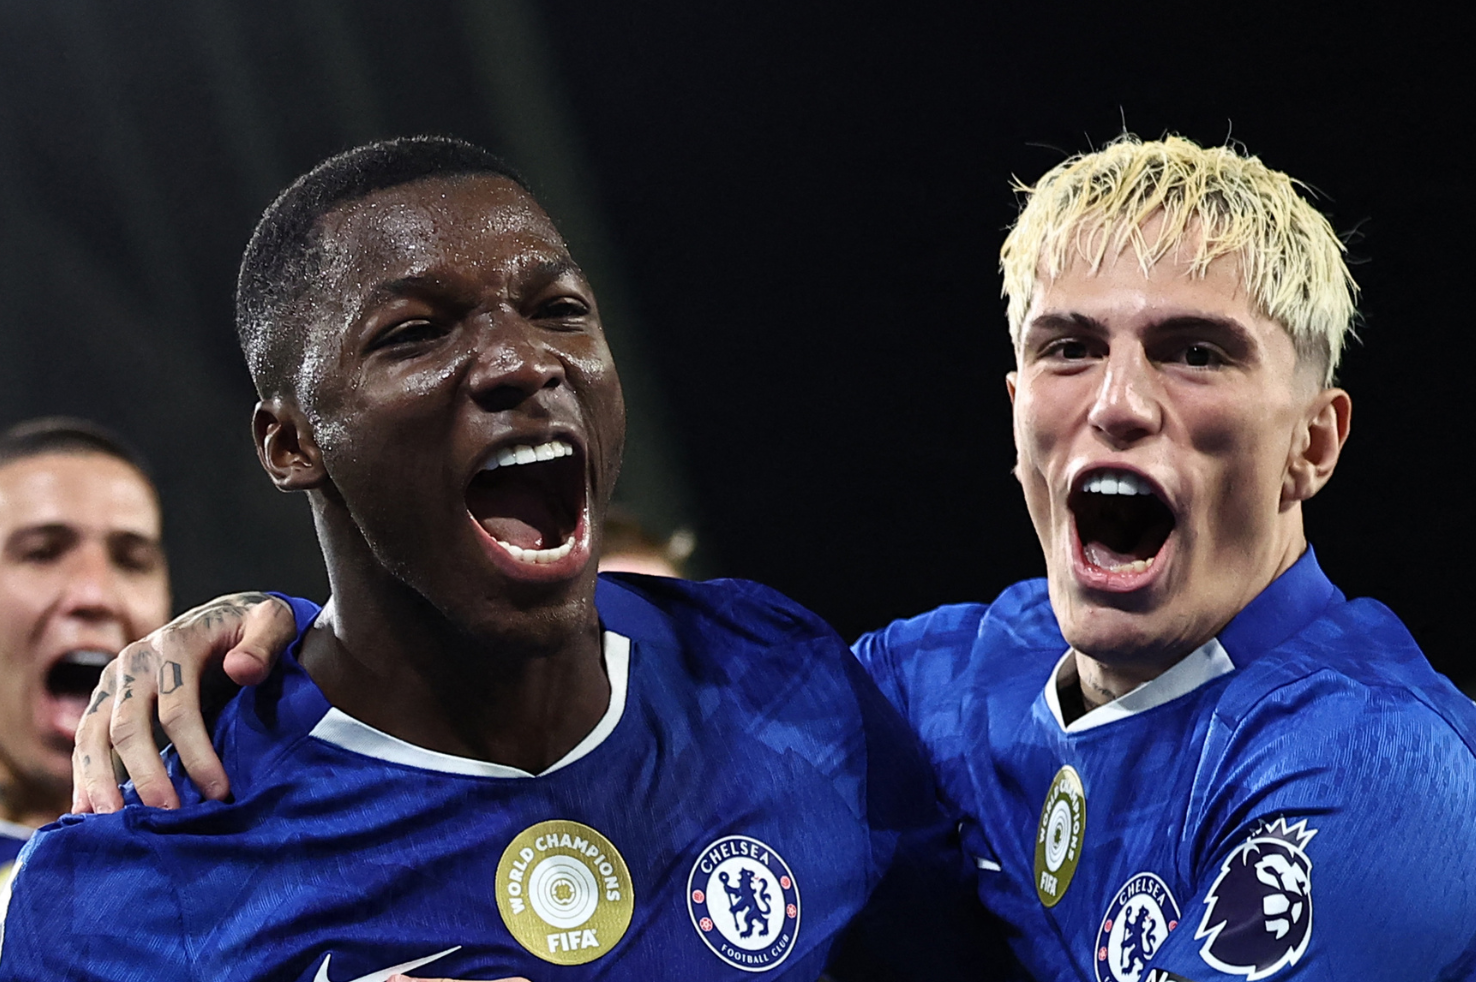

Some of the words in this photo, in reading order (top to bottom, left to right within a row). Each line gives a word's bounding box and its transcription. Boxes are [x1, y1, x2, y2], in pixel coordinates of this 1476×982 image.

[1039, 785, 1060, 843] WORLD
[700, 841, 770, 874] CHELSEA
[508, 847, 535, 915] WORLD
[535, 833, 621, 902] CHAMPIONS
[1040, 870, 1058, 897] FIFA
[1119, 878, 1165, 907] CHELSEA
[546, 928, 600, 953] FIFA
[721, 944, 770, 964] FOOTBALL
[771, 934, 790, 957] CLUB
